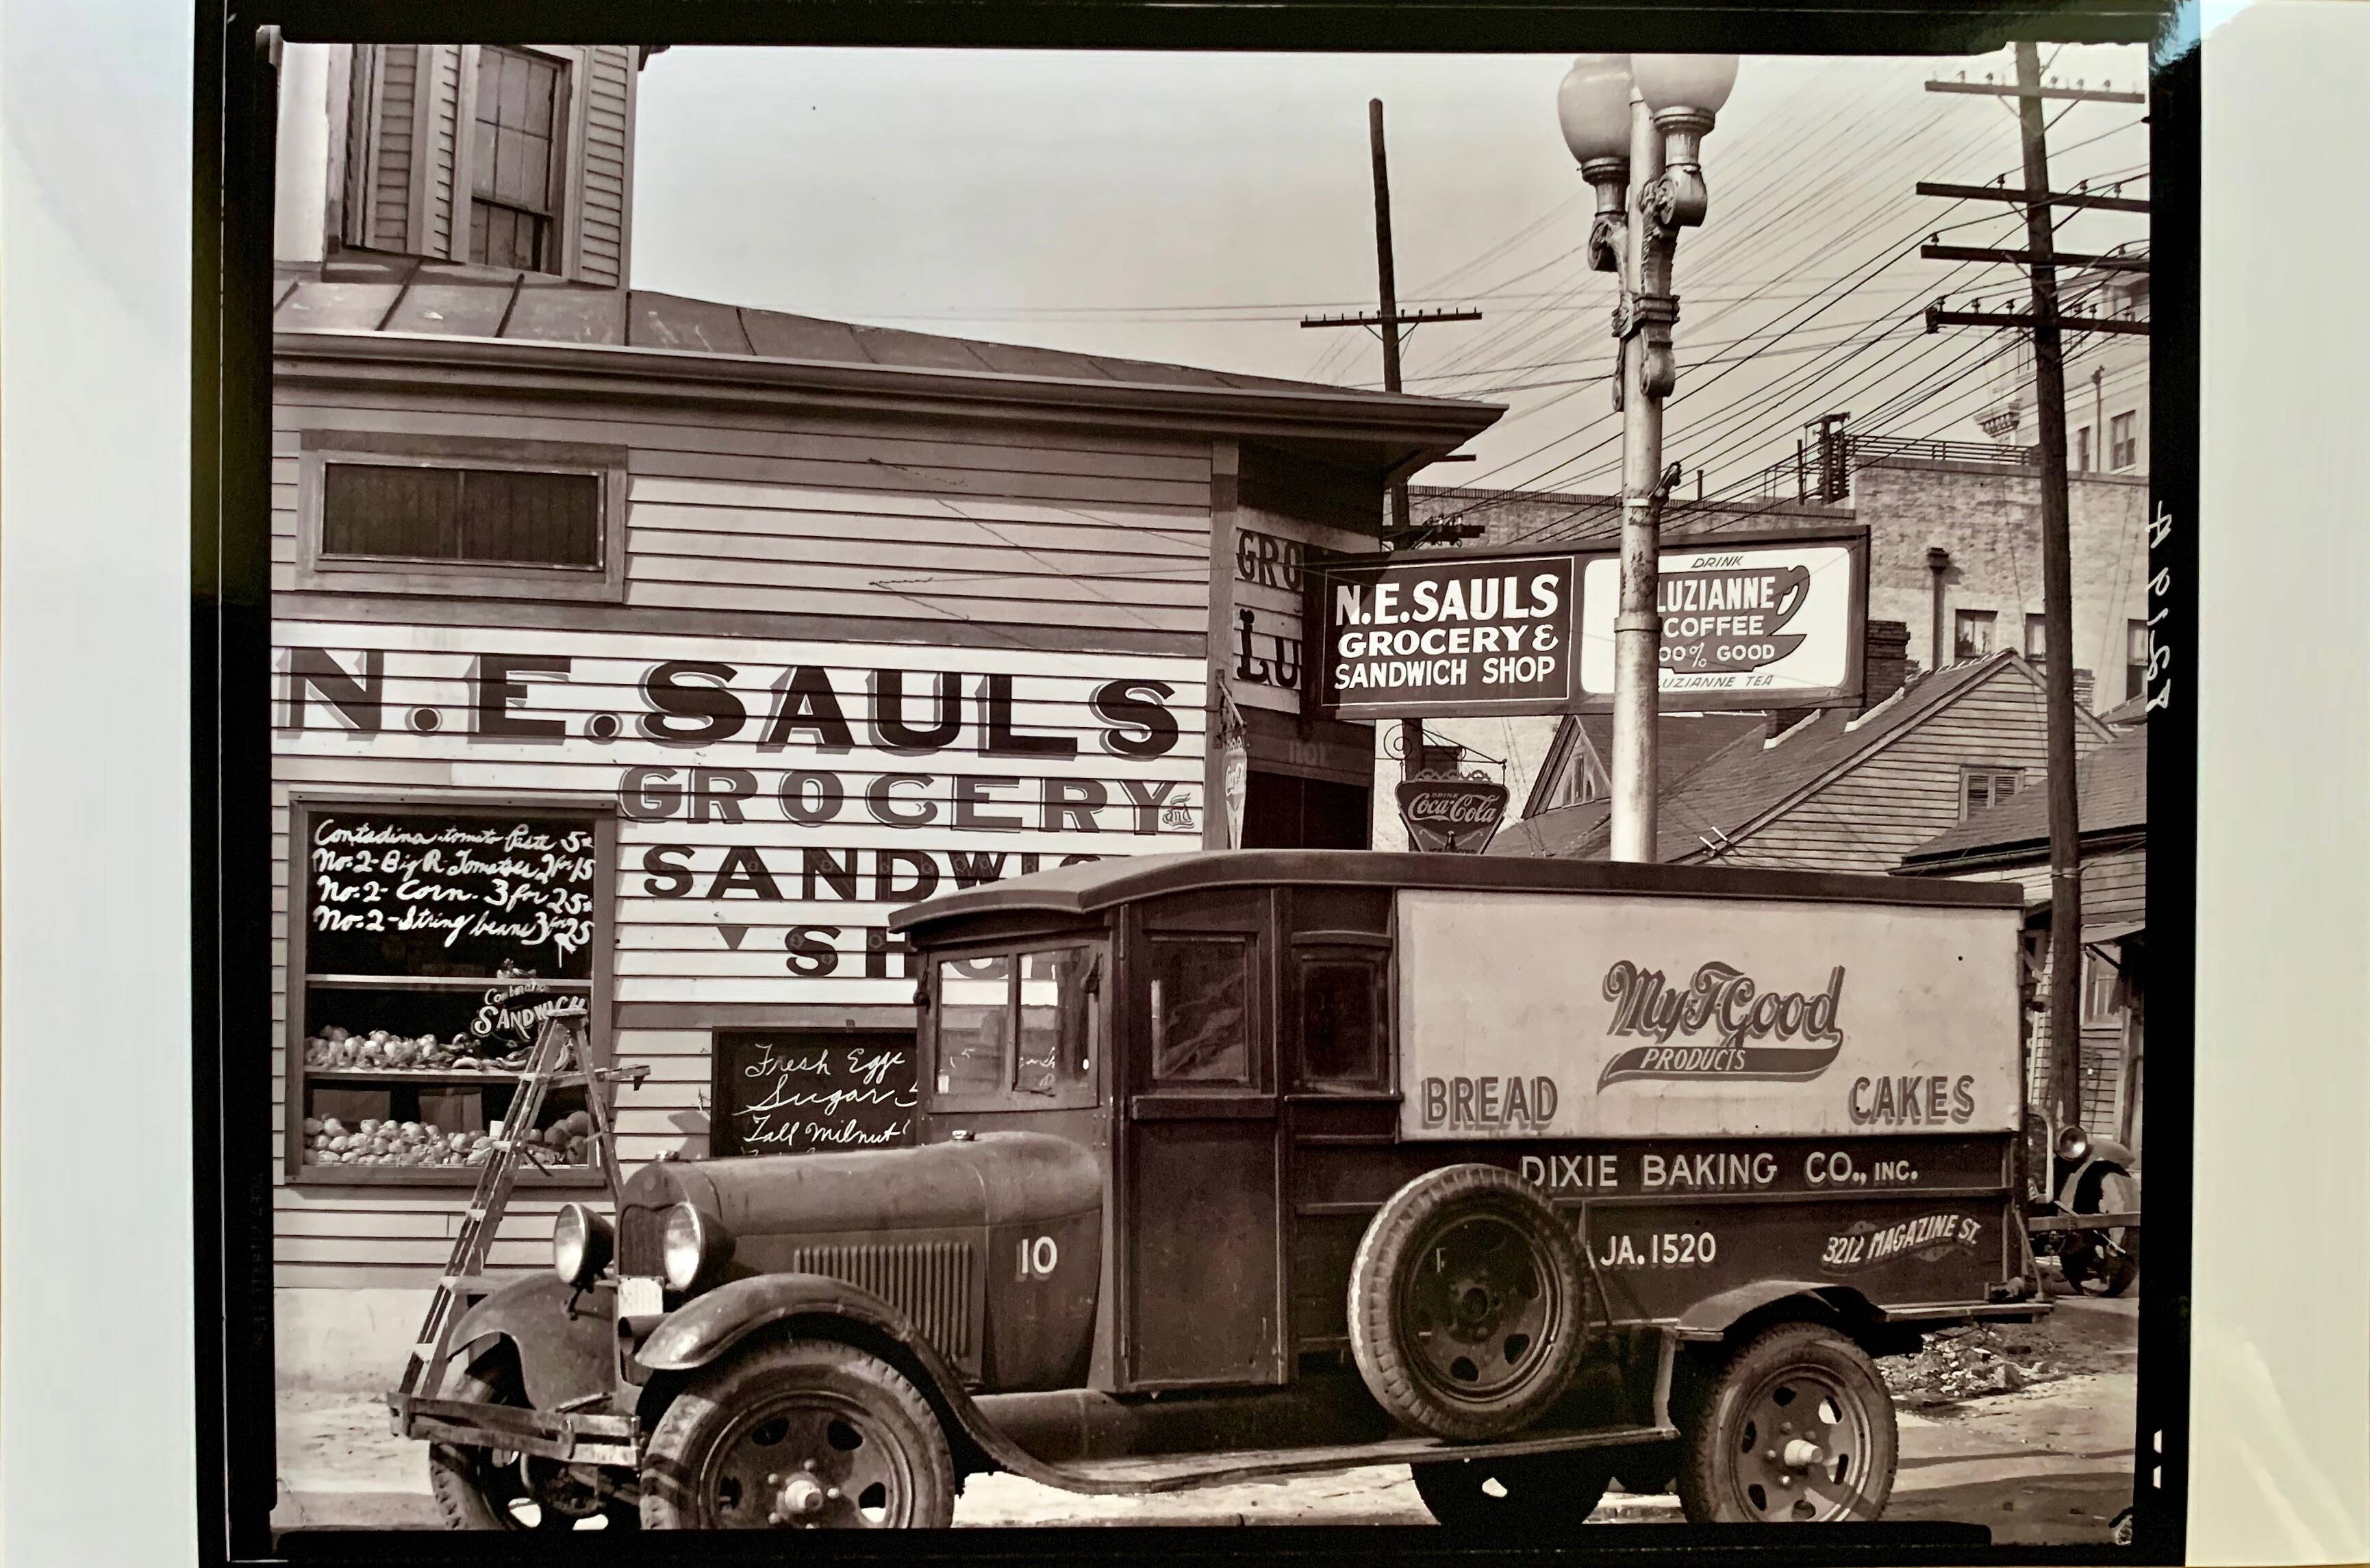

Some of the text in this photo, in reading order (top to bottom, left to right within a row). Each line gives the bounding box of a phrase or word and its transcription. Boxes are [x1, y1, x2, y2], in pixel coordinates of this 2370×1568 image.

[1691, 556, 1743, 568] DRINK
[1339, 624, 1559, 658] GROCERY &
[1663, 615, 1765, 637] COFFEE
[1658, 642, 1775, 668] 00% GOOD
[1335, 656, 1556, 690] SANDWICH SHOP
[1659, 674, 1774, 689] UZIANNE TEA
[619, 766, 1178, 835] GROCERY
[1408, 793, 1500, 822] Coca-Cola
[644, 846, 1134, 902] SANDW
[483, 878, 509, 906] 3
[472, 996, 586, 1039] SANDWICH
[745, 1044, 831, 1077] Fresh
[1640, 1048, 1746, 1071] PRODUCTS
[1420, 1076, 1558, 1129] BREAD
[1848, 1075, 1975, 1125] CAKES
[1522, 1154, 1617, 1188] DIXIE
[1643, 1152, 1778, 1186] BAKING
[1874, 1161, 1919, 1182] INC.
[1019, 1236, 1057, 1276] 10
[1652, 1232, 1717, 1265] 1520
[1822, 1214, 1982, 1265] 3212 MAGAZINE ST.
